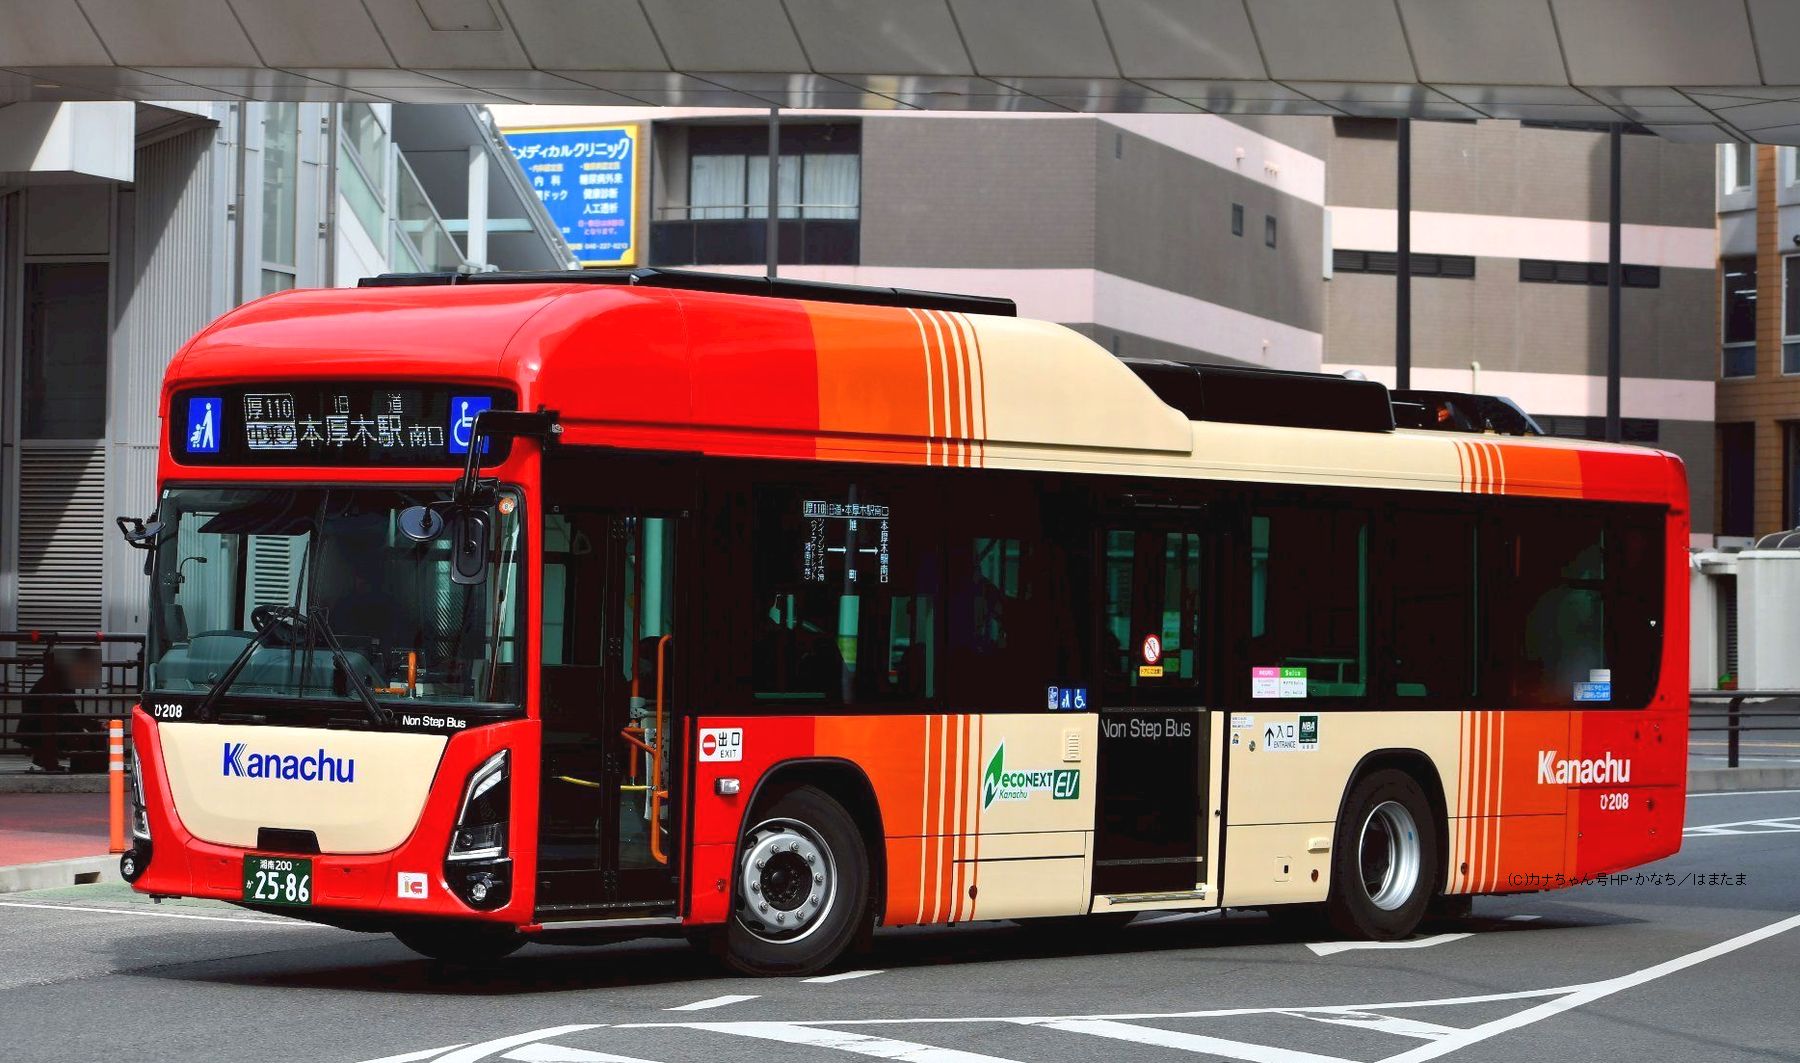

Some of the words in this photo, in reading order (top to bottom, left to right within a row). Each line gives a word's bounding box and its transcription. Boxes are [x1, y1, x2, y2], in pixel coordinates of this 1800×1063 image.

[247, 397, 292, 419] 厚110
[402, 715, 421, 727] Non
[423, 717, 444, 729] Step
[447, 717, 466, 729] Bus
[1130, 719, 1161, 740] Step
[1165, 719, 1191, 738] Bus
[718, 731, 740, 747] 出口
[1277, 725, 1294, 738] 入口
[720, 749, 737, 758] EXIT
[1273, 740, 1296, 749] ENTRANCE
[222, 742, 355, 783] Kanachu
[1537, 750, 1631, 785] Kanachu
[1055, 771, 1079, 798] EV
[999, 789, 1028, 799] Kanachu
[255, 870, 310, 903] 25-86
